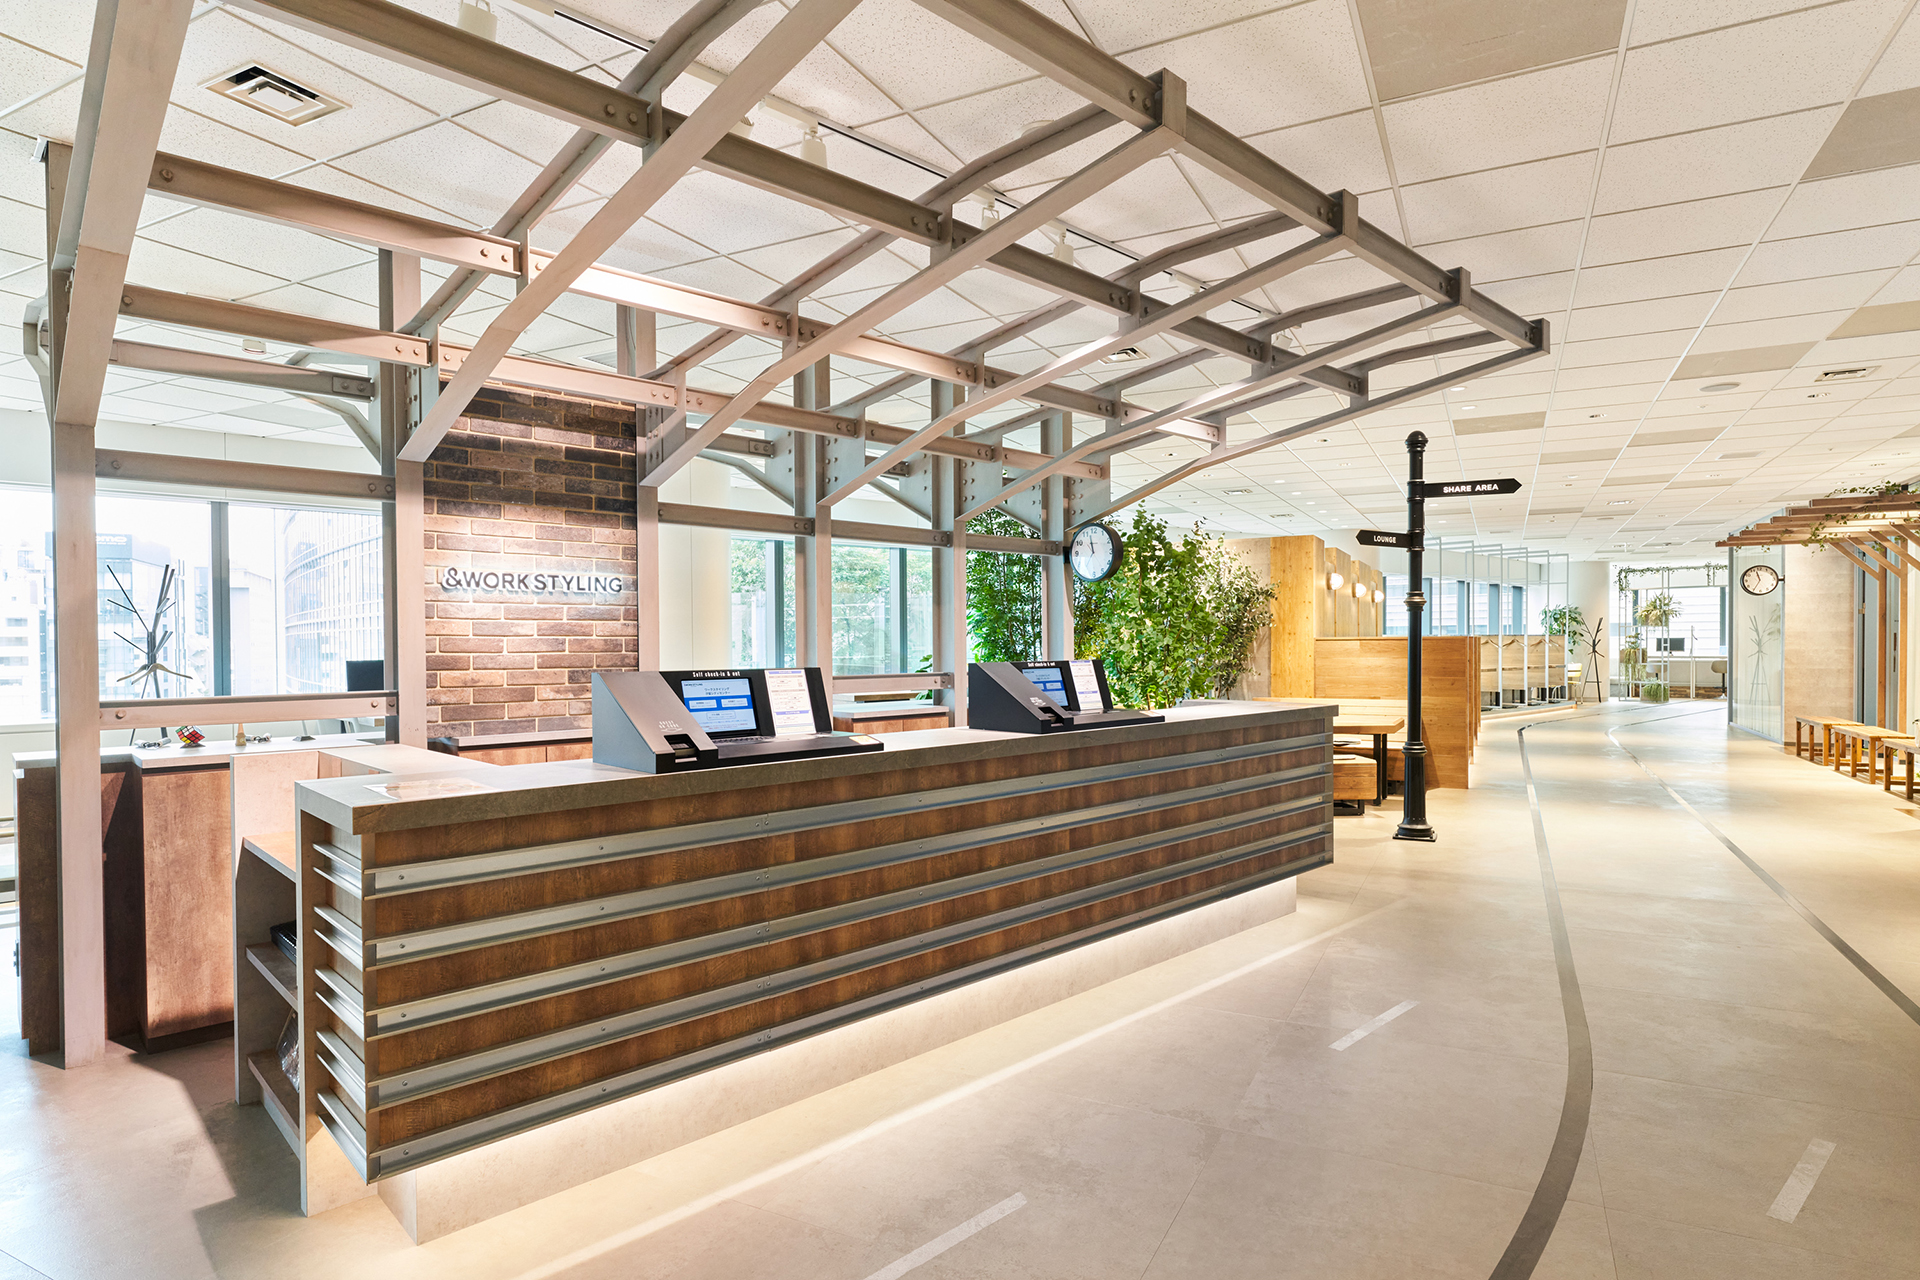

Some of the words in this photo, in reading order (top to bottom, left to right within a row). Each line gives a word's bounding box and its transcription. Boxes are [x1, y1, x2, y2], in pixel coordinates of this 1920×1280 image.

[1443, 484, 1472, 494] SHARE
[1475, 483, 1499, 492] AREA
[1374, 535, 1397, 544] LOUNGE
